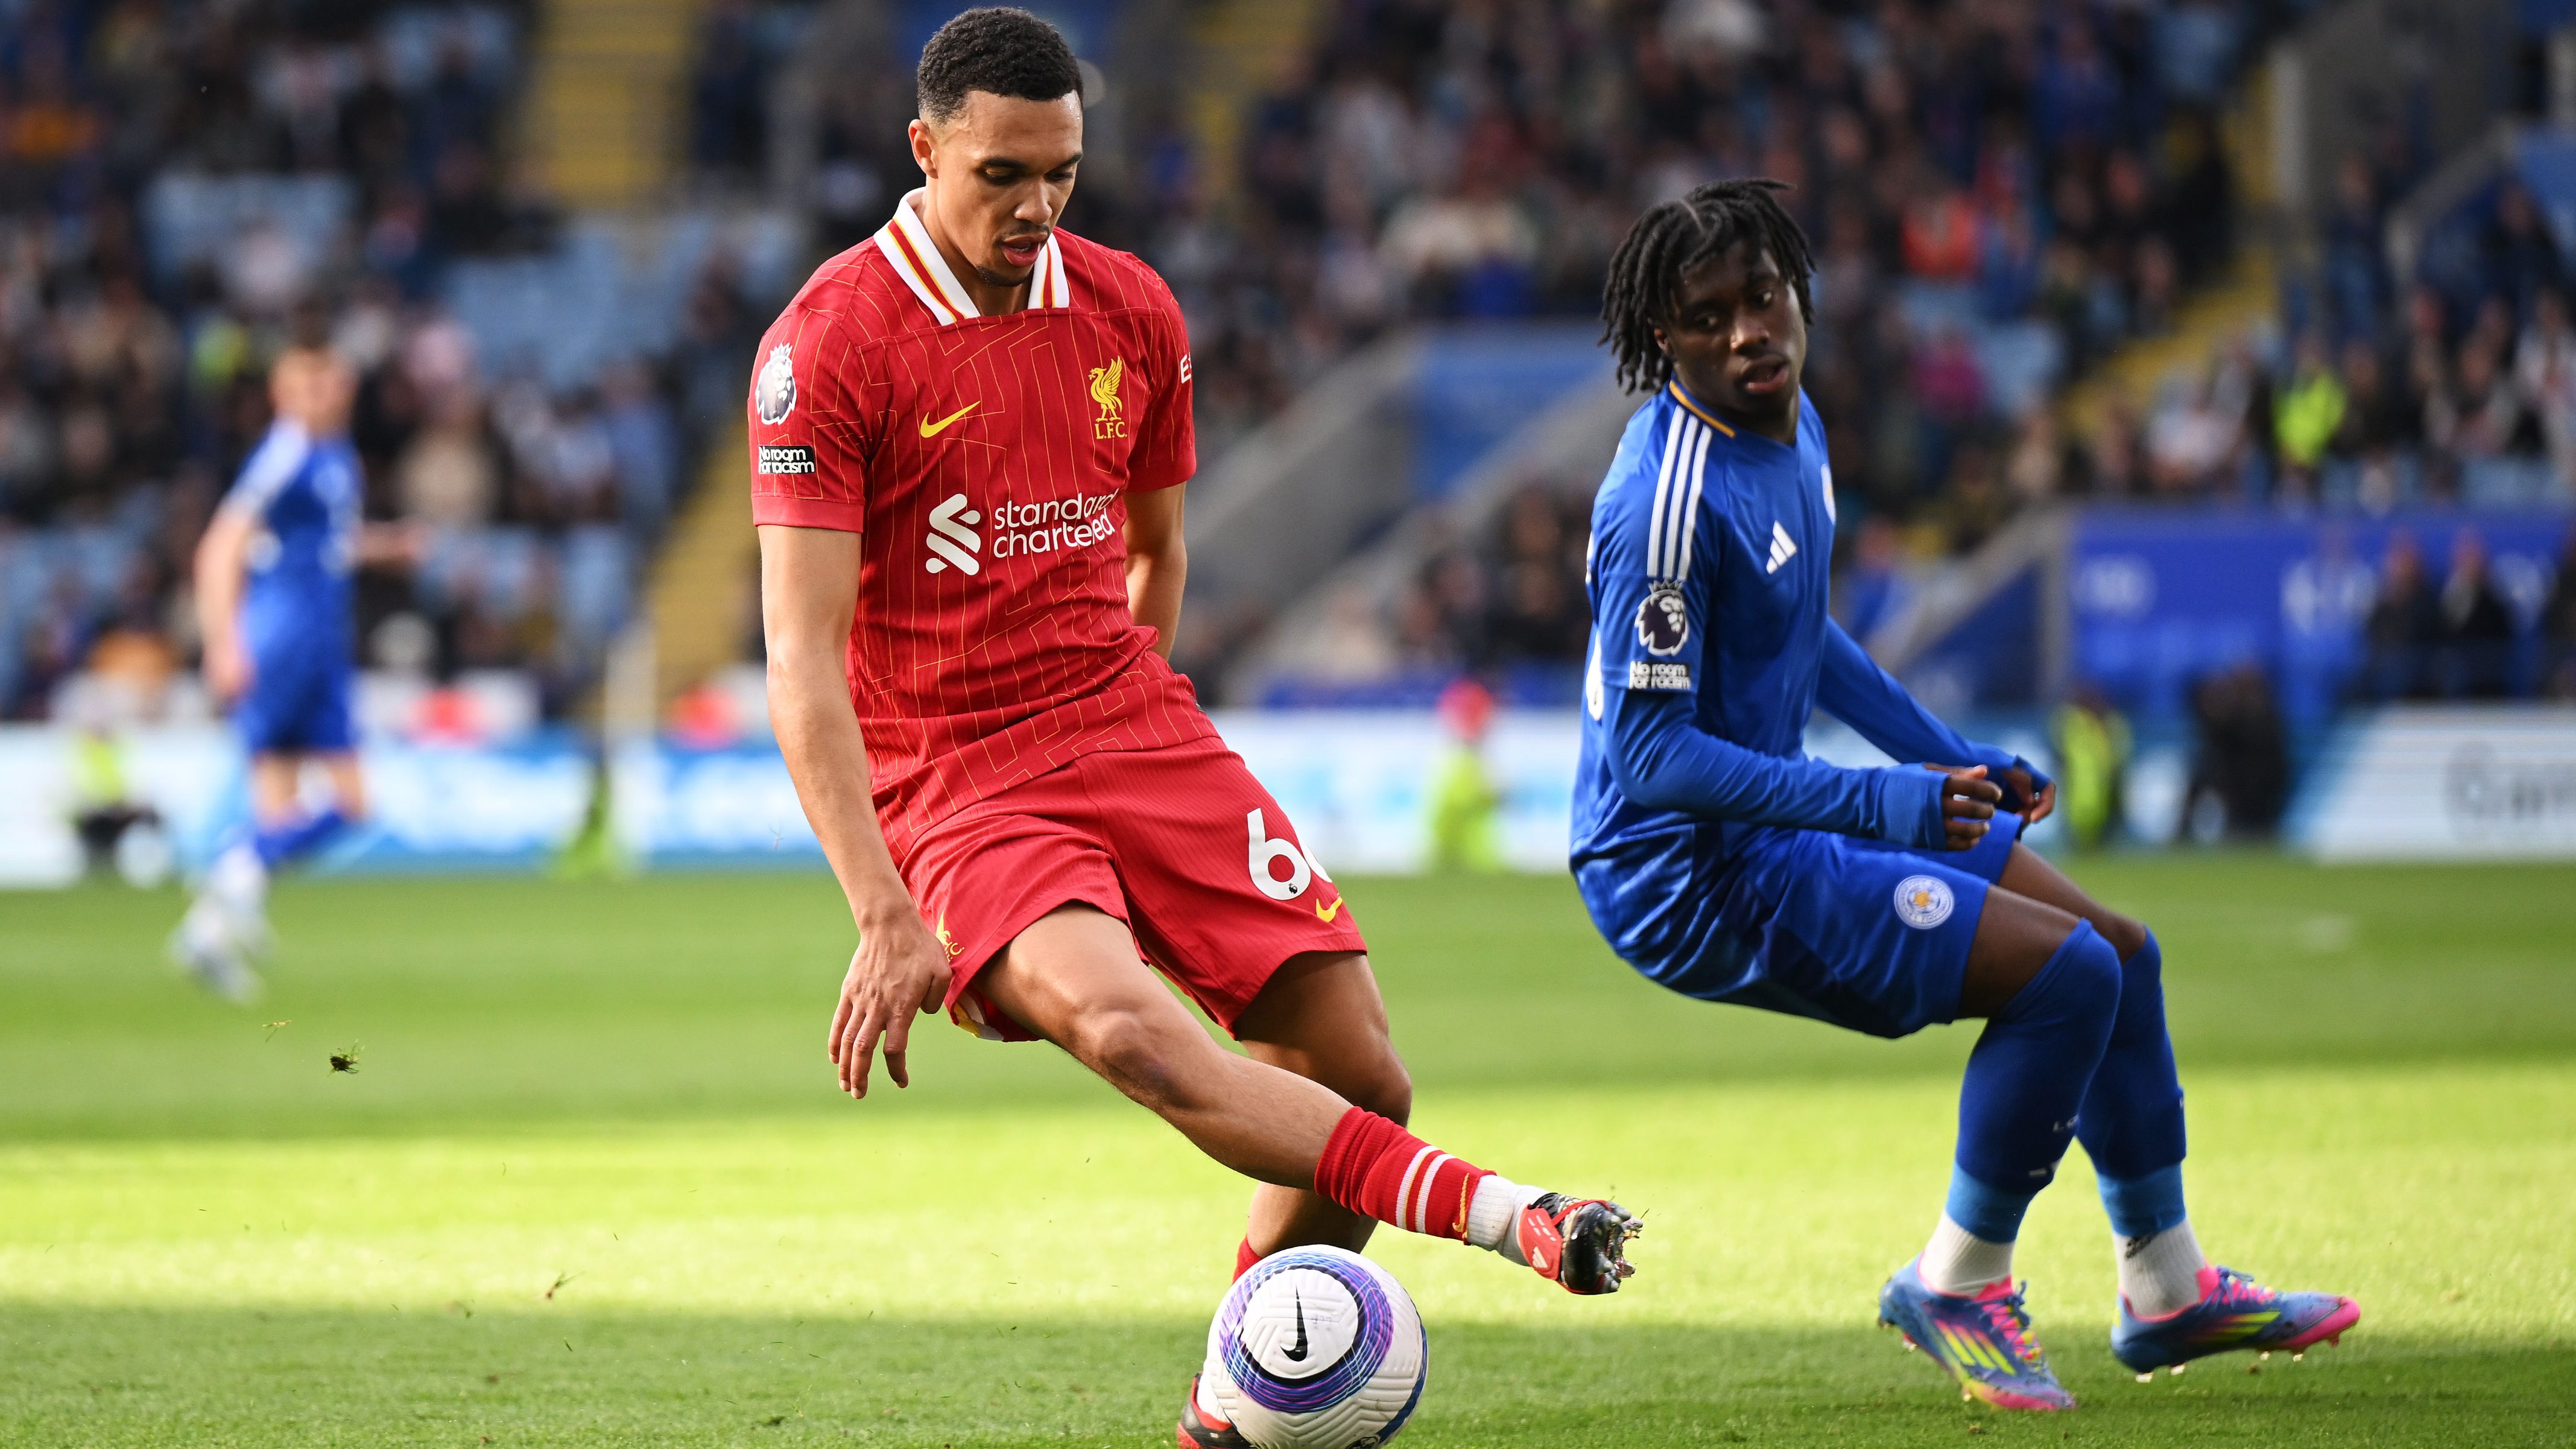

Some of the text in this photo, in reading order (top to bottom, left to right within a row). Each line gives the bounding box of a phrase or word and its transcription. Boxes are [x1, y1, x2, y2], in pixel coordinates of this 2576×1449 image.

[758, 446, 806, 461] No room
[771, 461, 815, 474] racism
[995, 487, 1119, 530] standard
[1630, 661, 1686, 676] No room
[1247, 807, 1333, 900] 6
